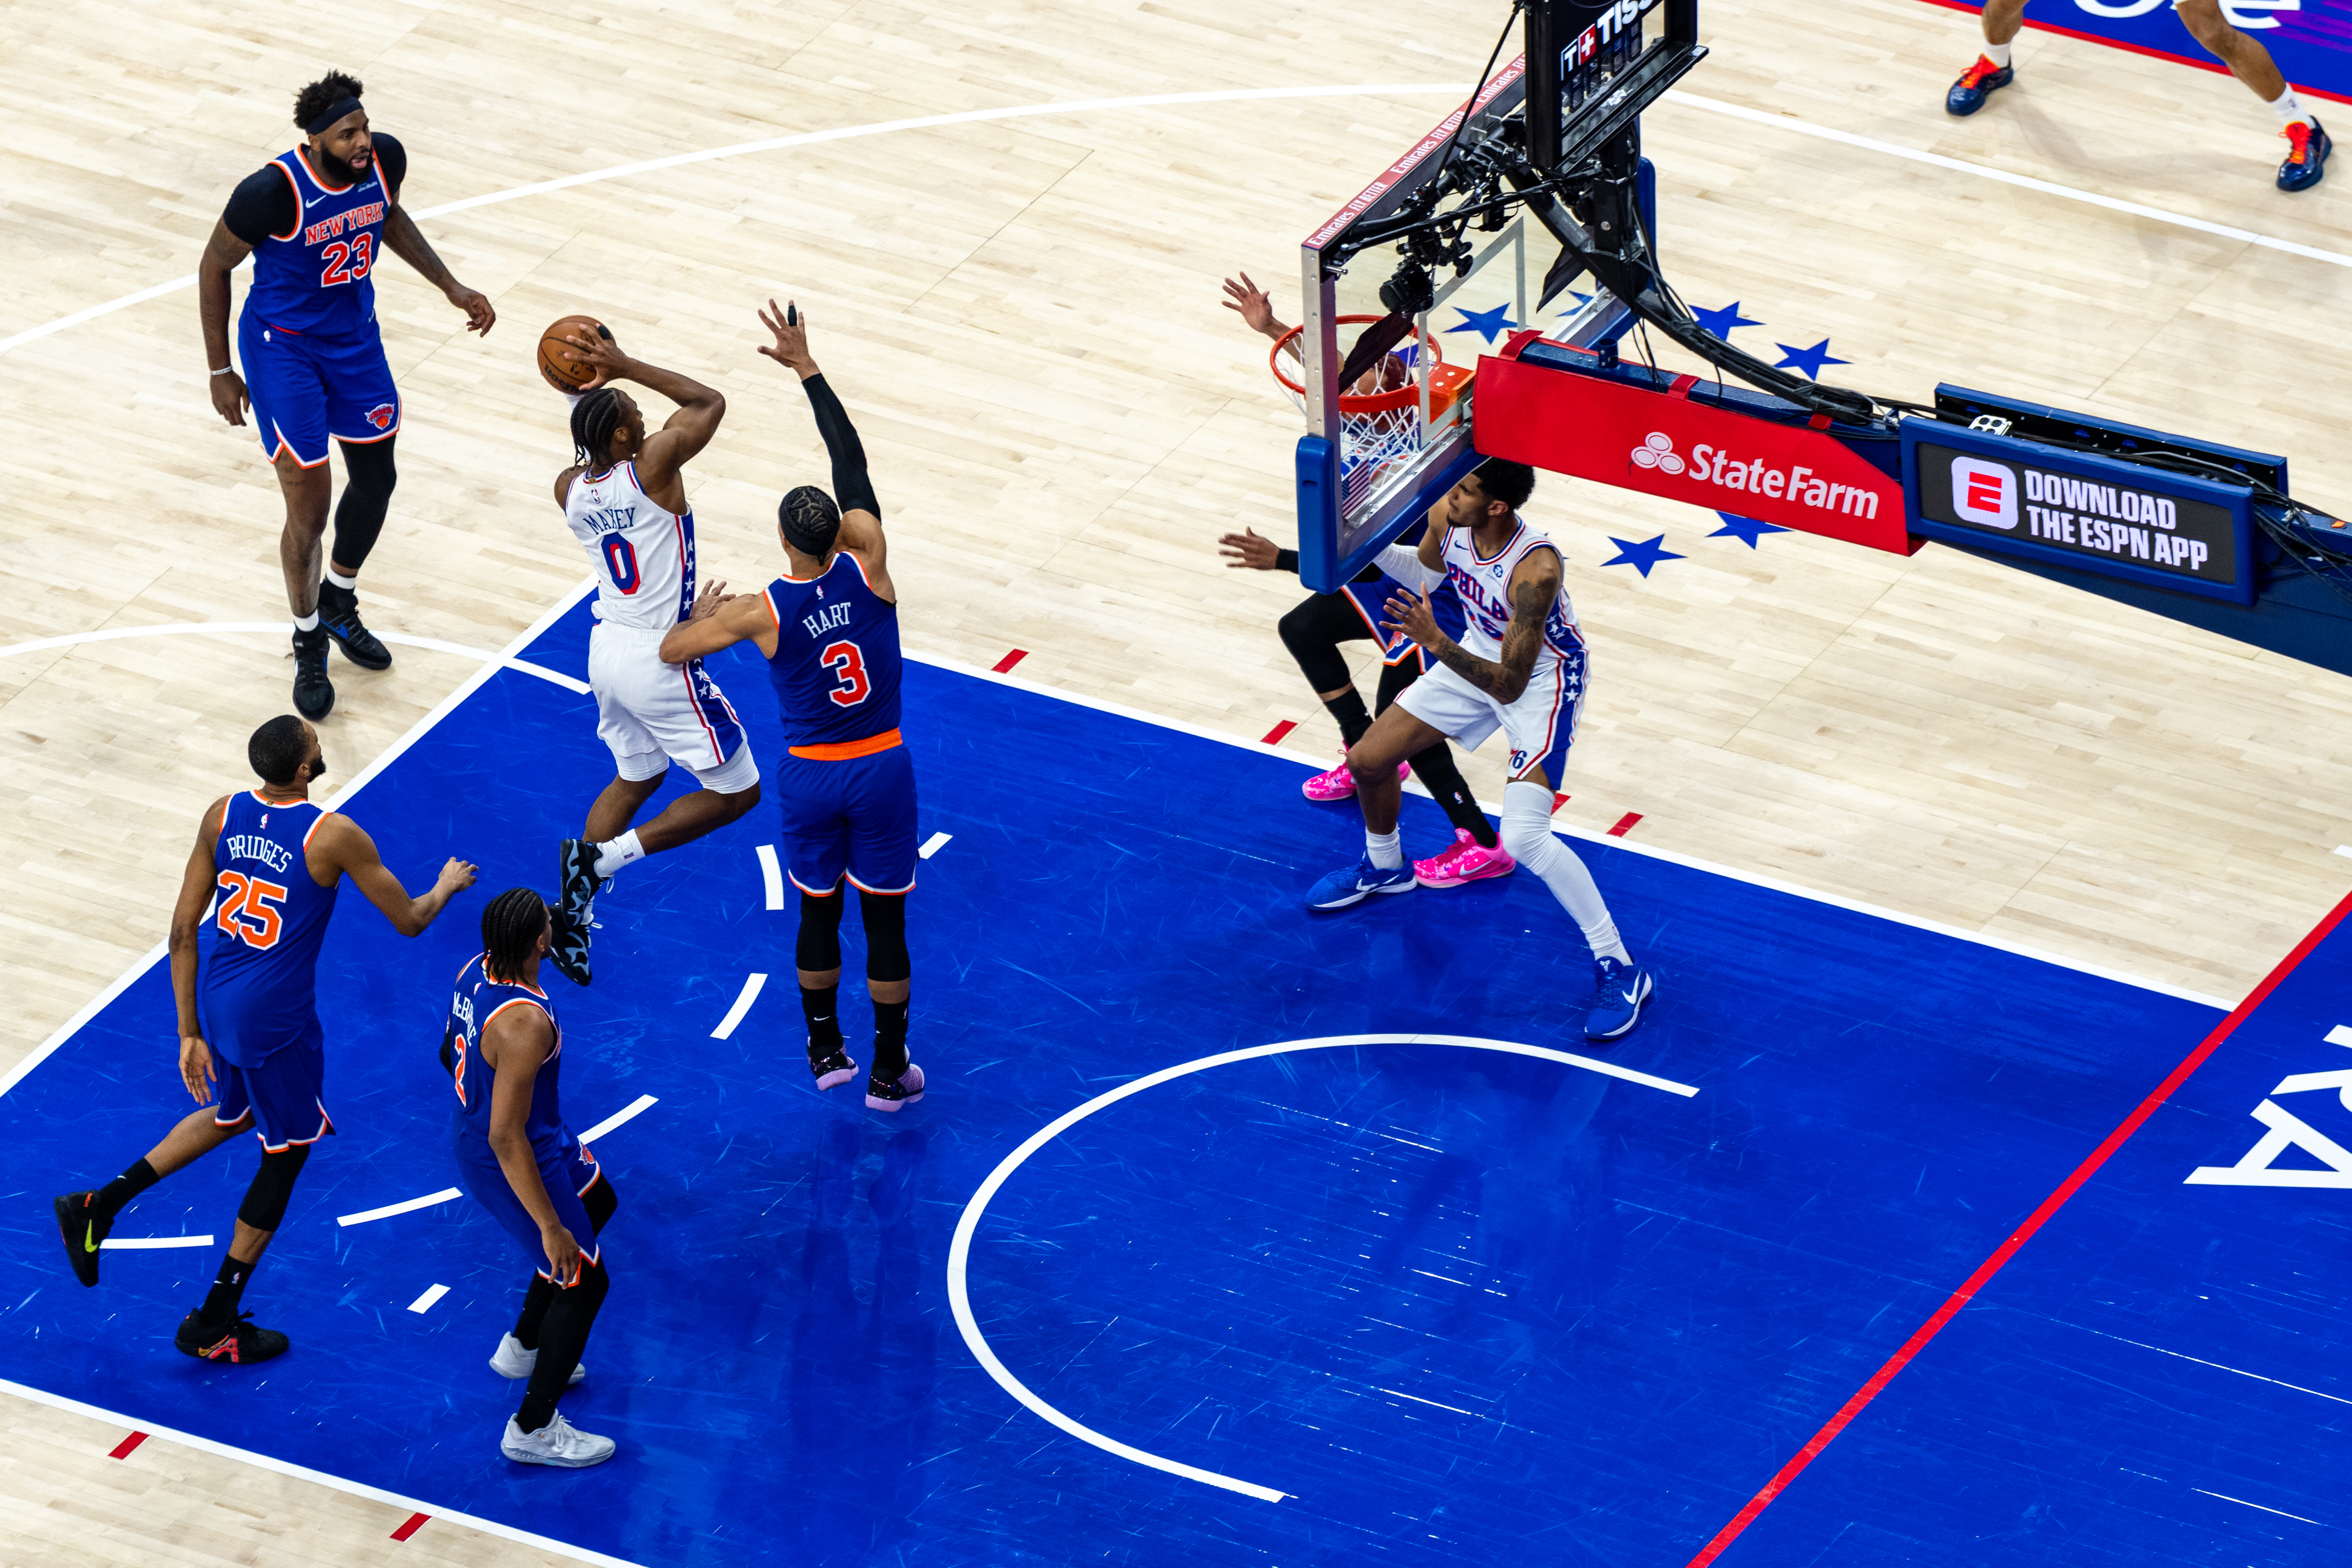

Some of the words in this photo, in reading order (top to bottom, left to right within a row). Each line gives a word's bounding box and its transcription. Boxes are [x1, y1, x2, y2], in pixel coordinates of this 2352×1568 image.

[1306, 211, 1355, 245] Emirates
[1348, 200, 1367, 211] FLY
[1358, 182, 1389, 203] BETTER
[1389, 140, 1438, 174] Emirates
[1430, 128, 1449, 140] FLY
[305, 215, 344, 246] NEW
[345, 201, 384, 231] YORK
[321, 232, 373, 288] 23
[1689, 443, 1785, 498] State
[1786, 466, 1879, 520] Farm
[2024, 469, 2177, 530] DOWNLOAD
[583, 507, 636, 535] MAXEY
[2026, 505, 2076, 544] THE
[2078, 516, 2150, 560] ESPN
[2154, 533, 2208, 571] APP
[601, 531, 641, 596] 0
[1446, 560, 1510, 622] PHILA
[802, 602, 852, 639] HART
[820, 639, 872, 707] 3
[226, 835, 292, 873] BRIDGES
[217, 868, 288, 951] 25
